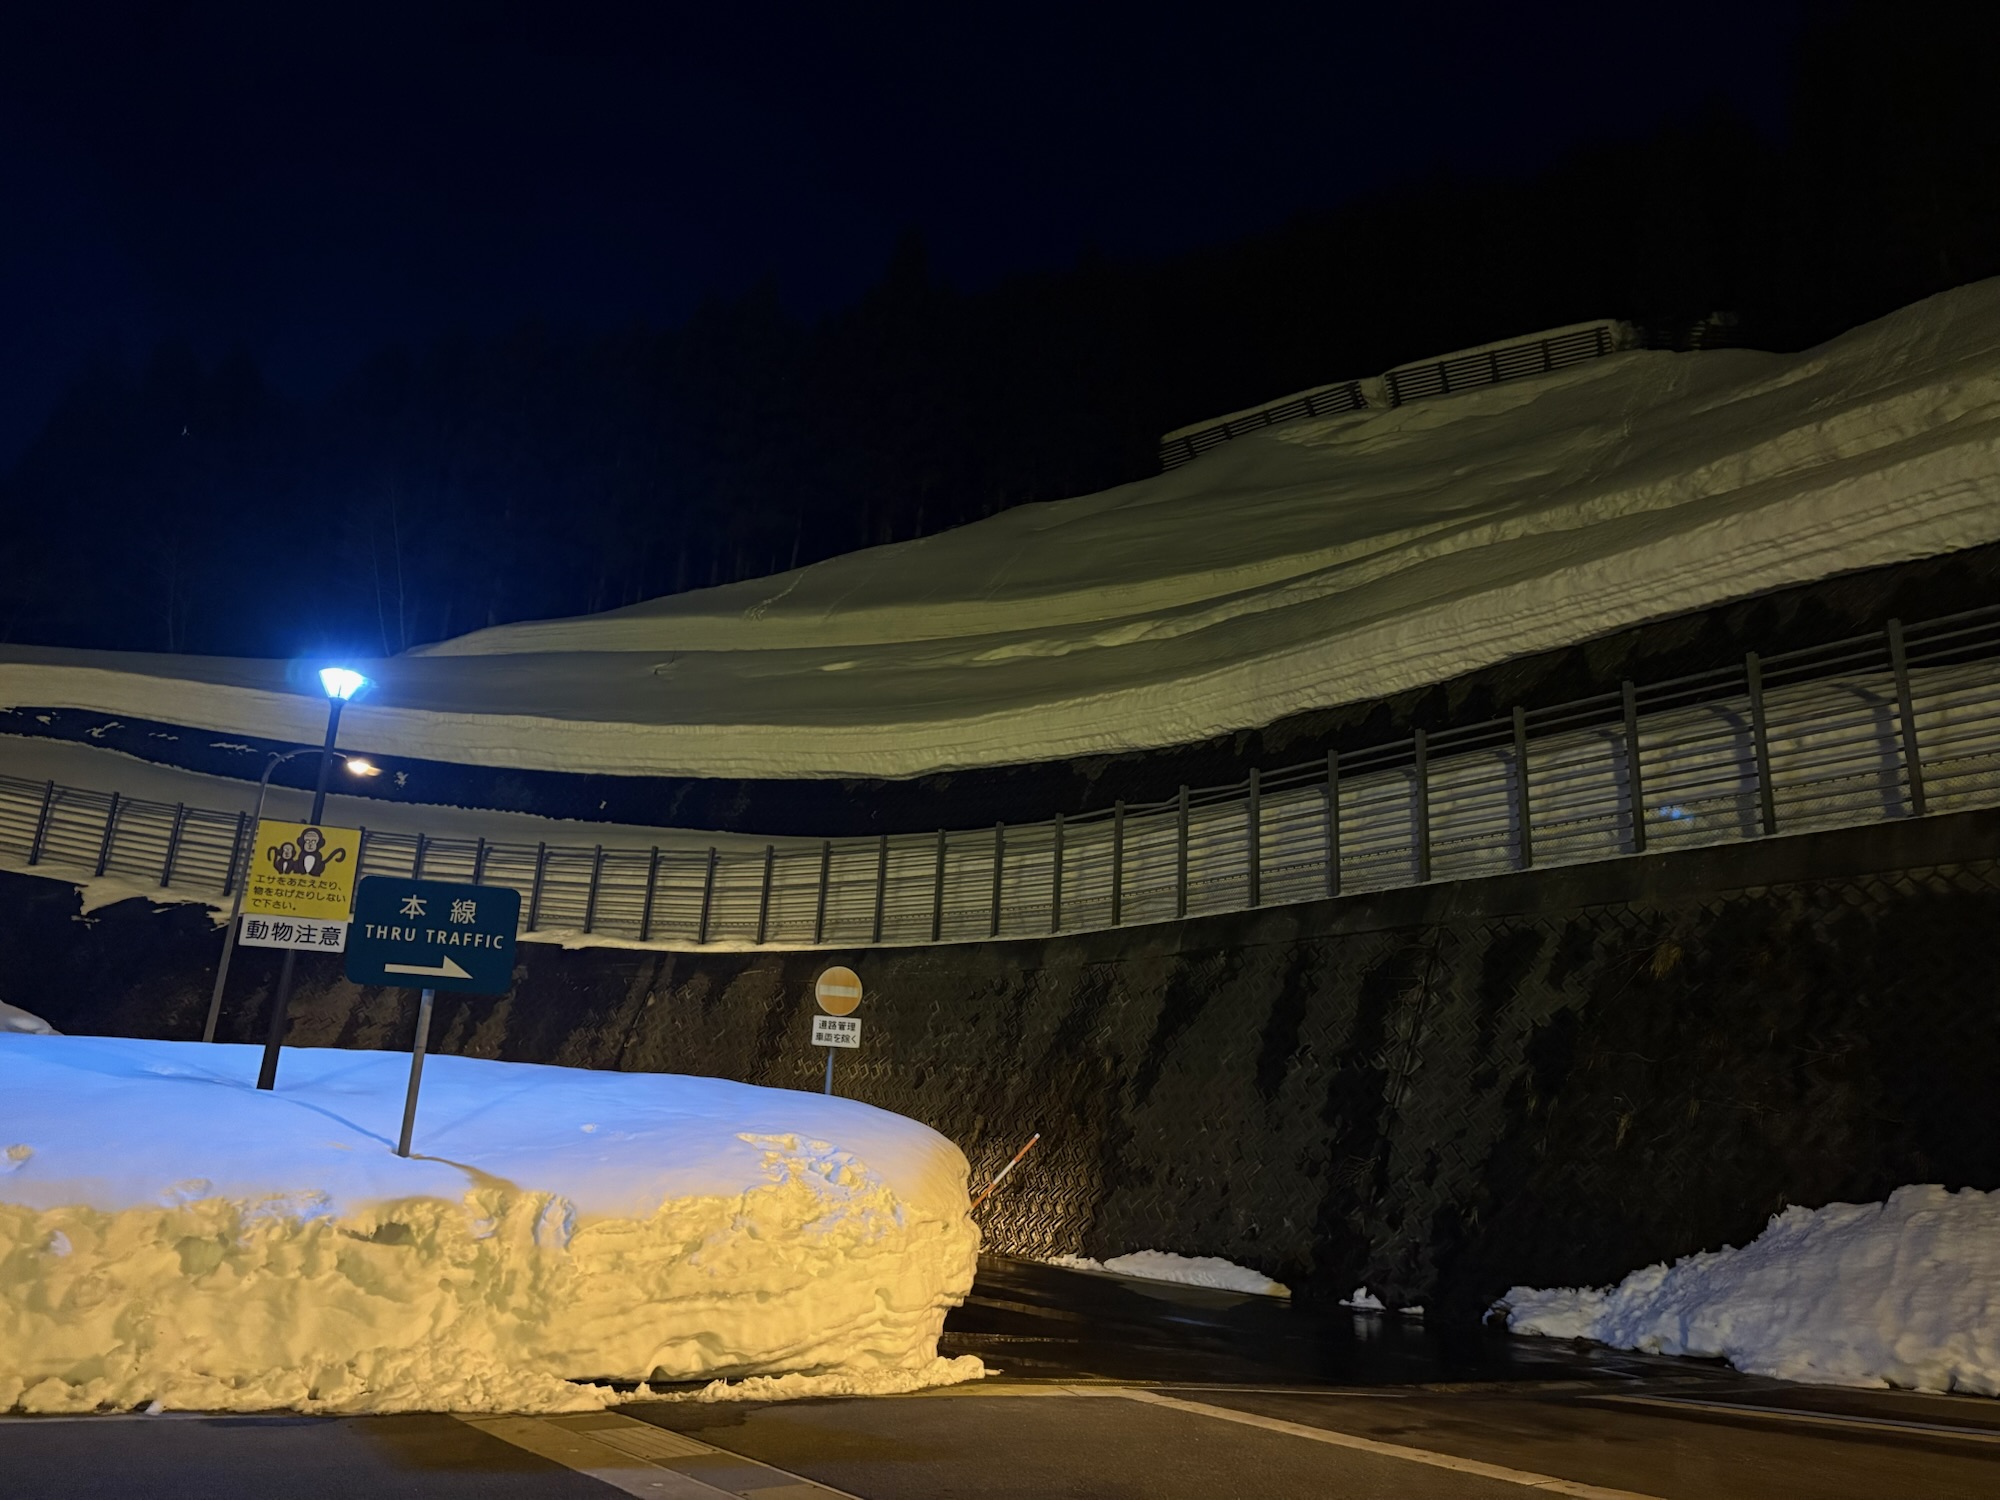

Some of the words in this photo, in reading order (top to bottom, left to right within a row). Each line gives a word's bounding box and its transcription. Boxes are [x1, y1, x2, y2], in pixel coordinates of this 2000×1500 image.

[255, 874, 342, 891] エサをあたえたり、
[253, 886, 346, 903] 物をなげたりしない
[252, 898, 296, 911] で下さい。
[246, 920, 342, 946] 動物注意
[365, 924, 416, 942] THRU
[426, 929, 504, 950] TRAFFIC
[818, 1019, 856, 1031] 道路管理
[815, 1032, 857, 1044] 車両を除く
